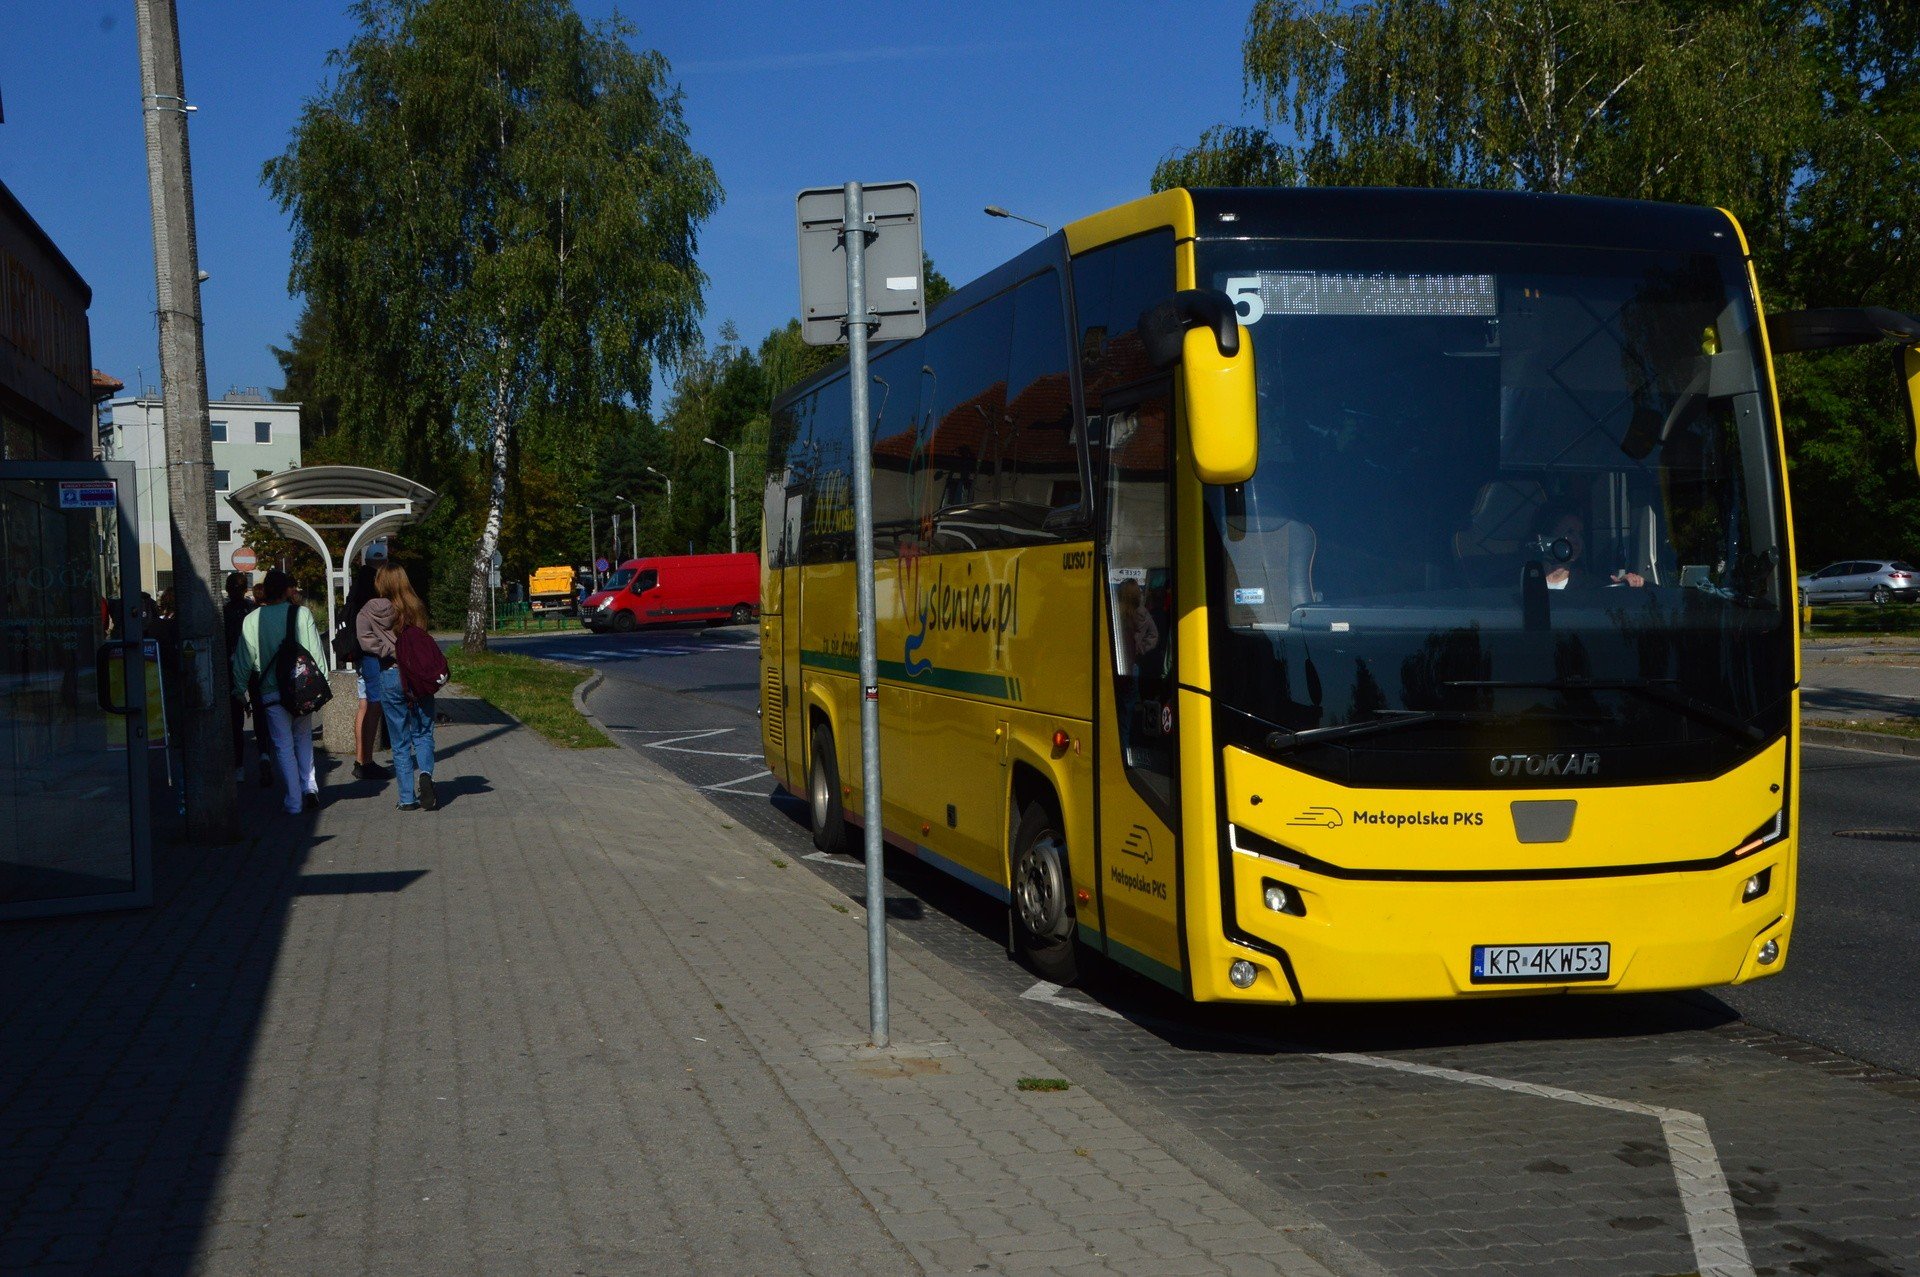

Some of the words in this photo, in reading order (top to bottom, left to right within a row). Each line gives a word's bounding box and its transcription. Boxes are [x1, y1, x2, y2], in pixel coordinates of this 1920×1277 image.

[1225, 276, 1265, 326] 5
[1262, 275, 1313, 309] M2
[1063, 551, 1086, 570] ULYSO
[1489, 752, 1601, 777] OTOKAR
[1453, 811, 1484, 826] PKS
[1152, 879, 1167, 900] PKS
[1474, 965, 1484, 973] PL
[1489, 949, 1521, 975] KR
[1530, 947, 1602, 974] 4KW53
